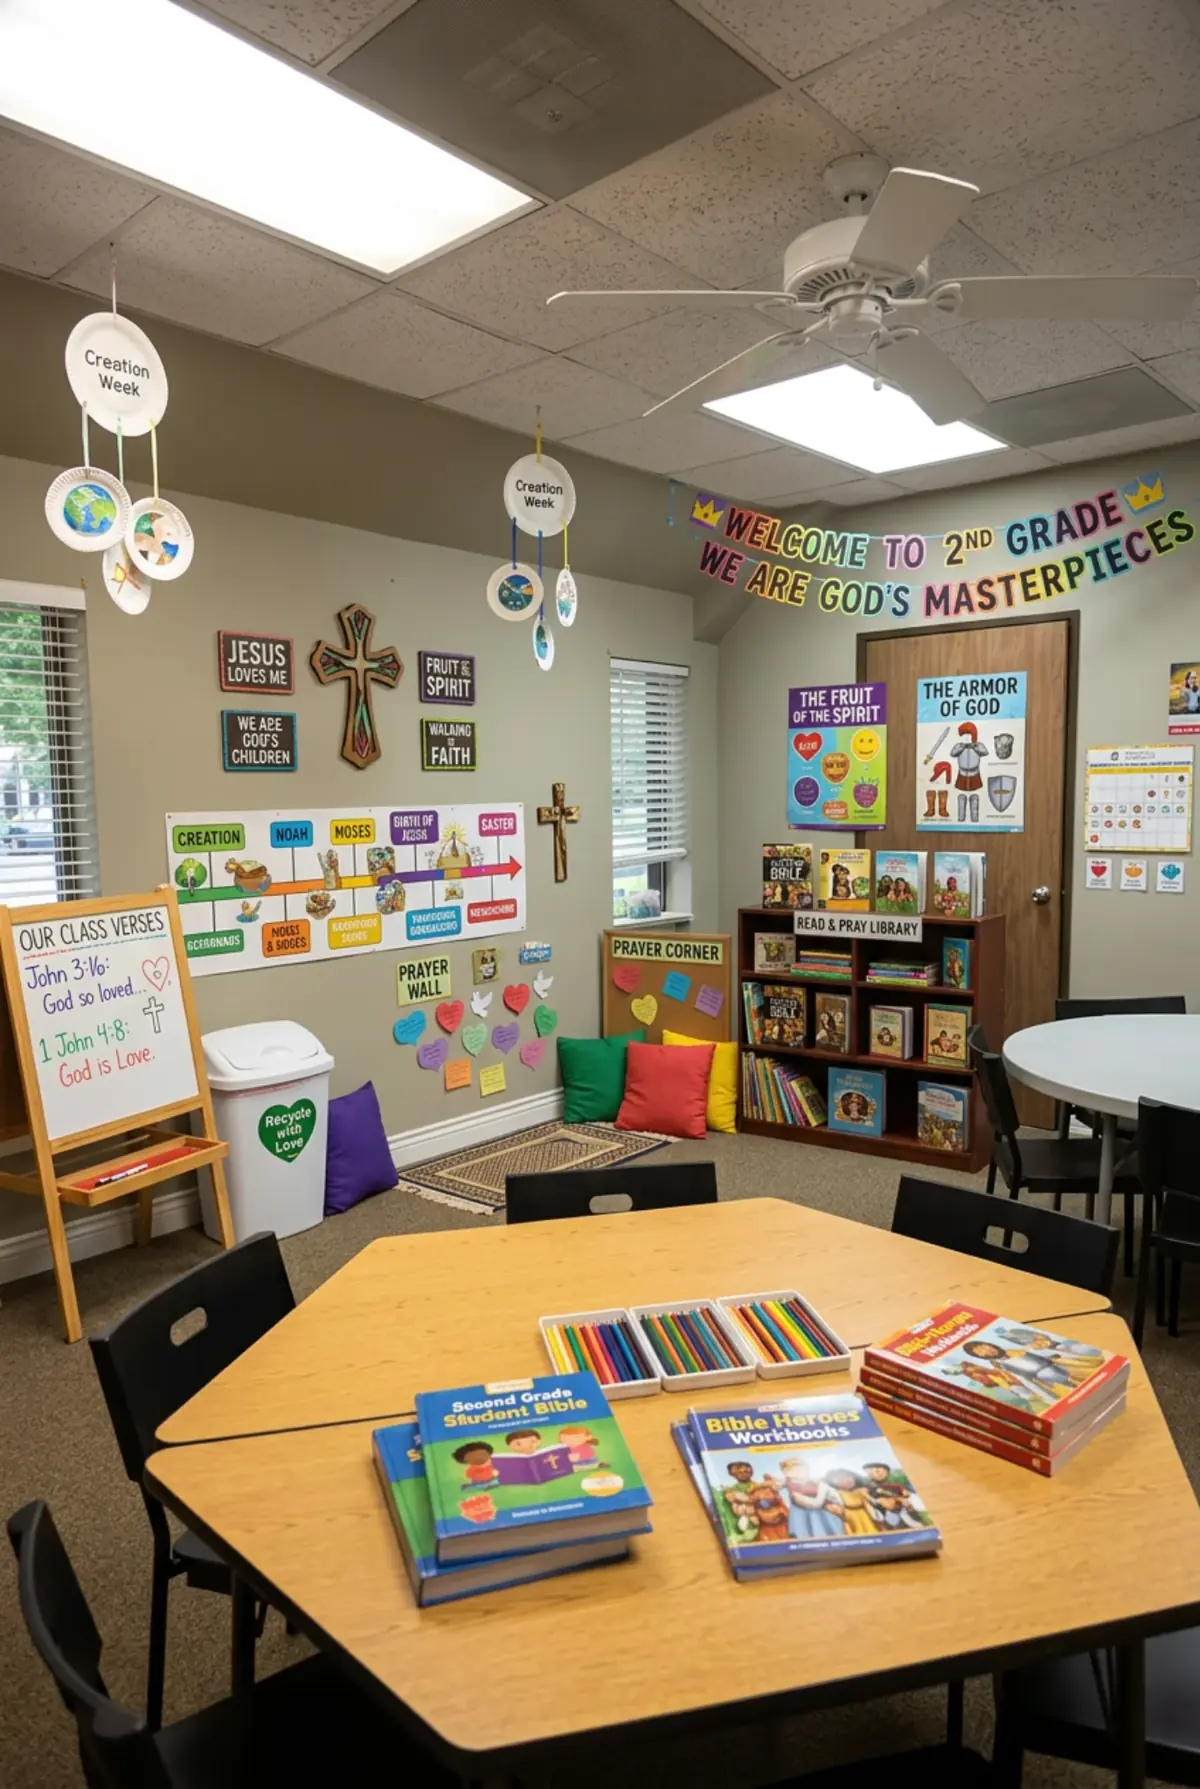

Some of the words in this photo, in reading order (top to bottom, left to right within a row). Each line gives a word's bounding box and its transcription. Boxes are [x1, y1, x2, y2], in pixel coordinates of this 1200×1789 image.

[85, 349, 150, 379] Creation
[98, 373, 141, 397] Week
[515, 479, 563, 495] Creation
[524, 496, 555, 509] Week
[724, 507, 868, 567] WELCOME
[884, 537, 925, 568] TO
[945, 529, 993, 566] 2ND
[1006, 492, 1124, 556] GRADE
[699, 541, 744, 584] WE
[747, 563, 810, 605] ARE
[820, 578, 910, 617] GOD'S
[924, 510, 1195, 617] MASTERPIECES
[227, 640, 286, 667] JESUS
[227, 666, 266, 684] LOVES
[269, 669, 288, 685] ME
[426, 657, 460, 676] FRUIT
[426, 675, 472, 698] SPIRIT
[923, 680, 954, 700] THE
[958, 677, 1018, 698] ARMOR
[799, 690, 828, 708] THE
[830, 687, 874, 706] FRUIT
[940, 700, 961, 717] OF
[965, 697, 1001, 716] GOD
[237, 716, 257, 731] WE
[792, 711, 808, 724] OF
[809, 709, 831, 723] THE
[832, 706, 881, 724] SPIRIT
[231, 749, 290, 765] CHILDREN
[430, 746, 471, 765] FAITH
[177, 829, 241, 847] CREATION
[276, 827, 309, 842] NOAH
[334, 824, 371, 840] MOSES
[19, 925, 56, 951] OUR
[60, 920, 108, 945] CLASS
[110, 911, 164, 937] VERSES
[796, 916, 826, 931] READ
[828, 918, 836, 931] &
[839, 918, 868, 933] PRAY
[870, 921, 919, 936] LIBRARY
[613, 940, 662, 958] PRAYER
[665, 943, 720, 961] CORNER
[25, 964, 68, 990] John
[398, 959, 448, 982] PRAYER
[407, 979, 442, 1000] WALL
[43, 990, 74, 1015] God
[79, 990, 95, 1006] so
[39, 1038, 52, 1063] 1
[55, 1031, 94, 1059] John
[59, 1058, 92, 1088] God
[97, 1057, 112, 1076] is
[115, 1047, 156, 1070] Love.
[276, 1122, 302, 1140] with
[275, 1137, 304, 1153] Love
[533, 1398, 588, 1415] Bible
[705, 1415, 769, 1433] Bible
[772, 1410, 861, 1428] Heroes
